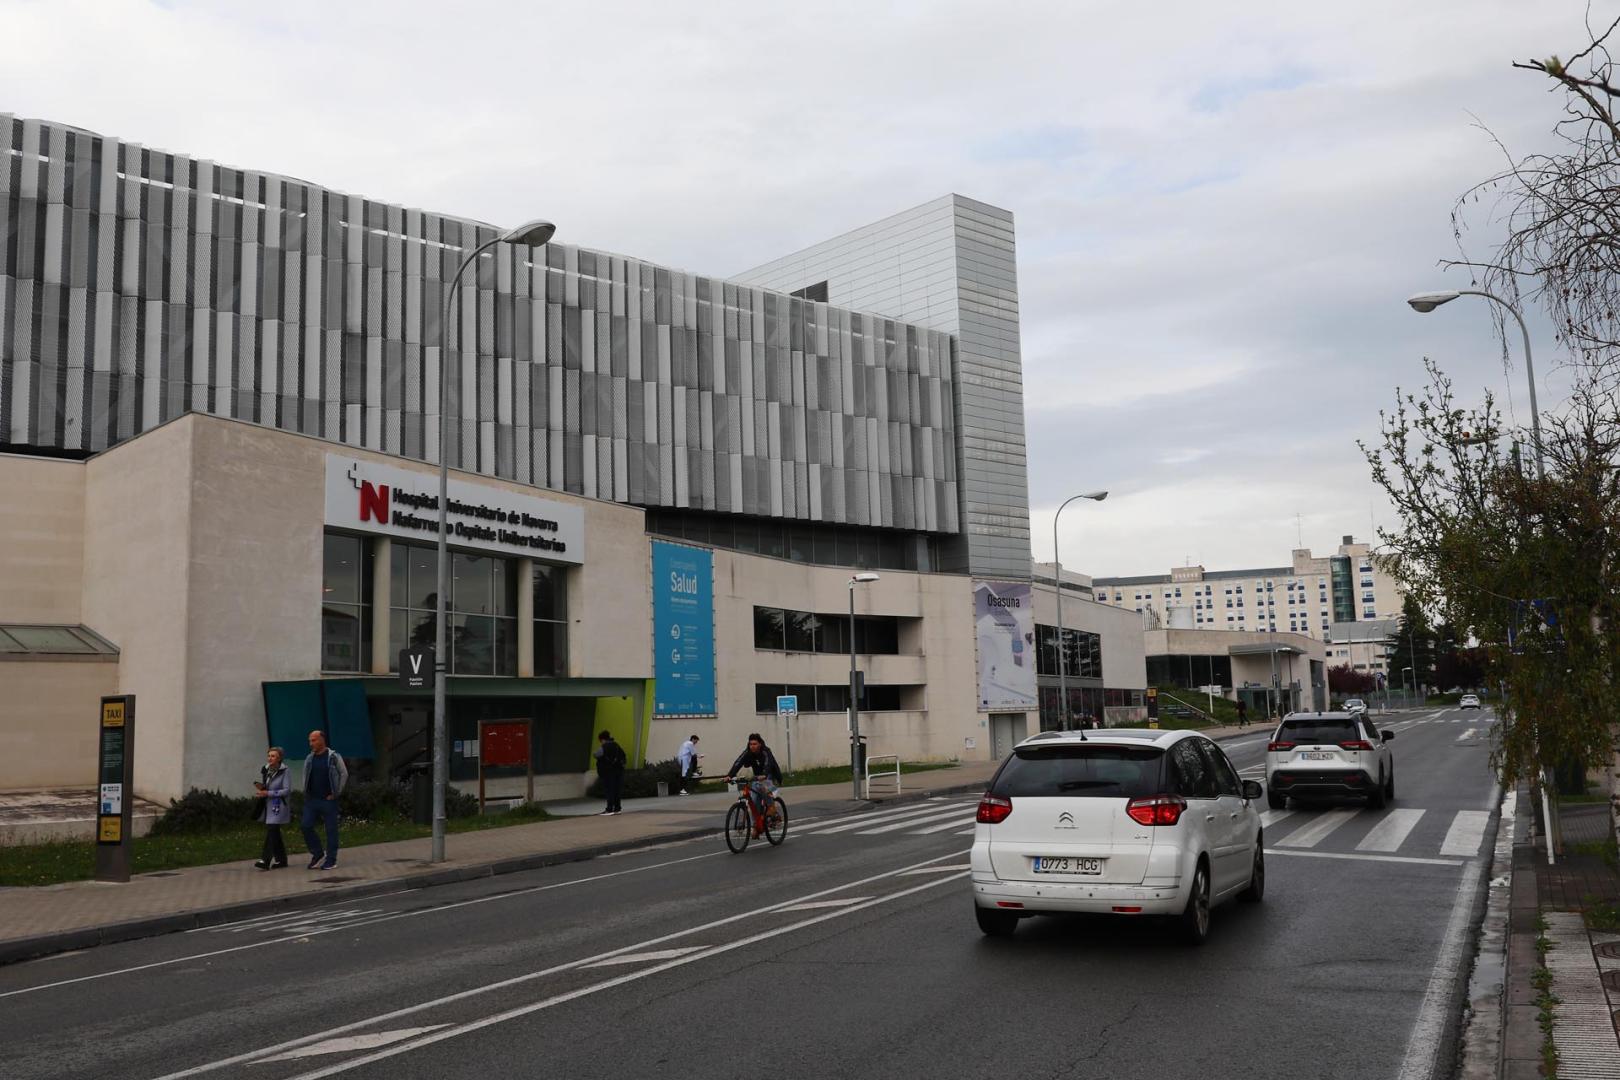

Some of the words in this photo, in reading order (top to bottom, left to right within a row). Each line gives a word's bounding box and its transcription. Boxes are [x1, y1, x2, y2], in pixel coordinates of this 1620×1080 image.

[360, 481, 389, 524] N
[393, 488, 439, 510] Hospital
[508, 510, 520, 524] de
[521, 512, 558, 532] Navarra
[392, 510, 453, 534] Nafarroao
[455, 521, 496, 542] Ospitale
[498, 528, 566, 552] Unibertsitarioa
[671, 571, 697, 594] Salud
[987, 593, 1020, 608] Osasuna
[409, 654, 423, 674] V
[106, 708, 122, 719] TAXI
[1041, 858, 1069, 870] 0773
[1076, 859, 1098, 871] HCG
